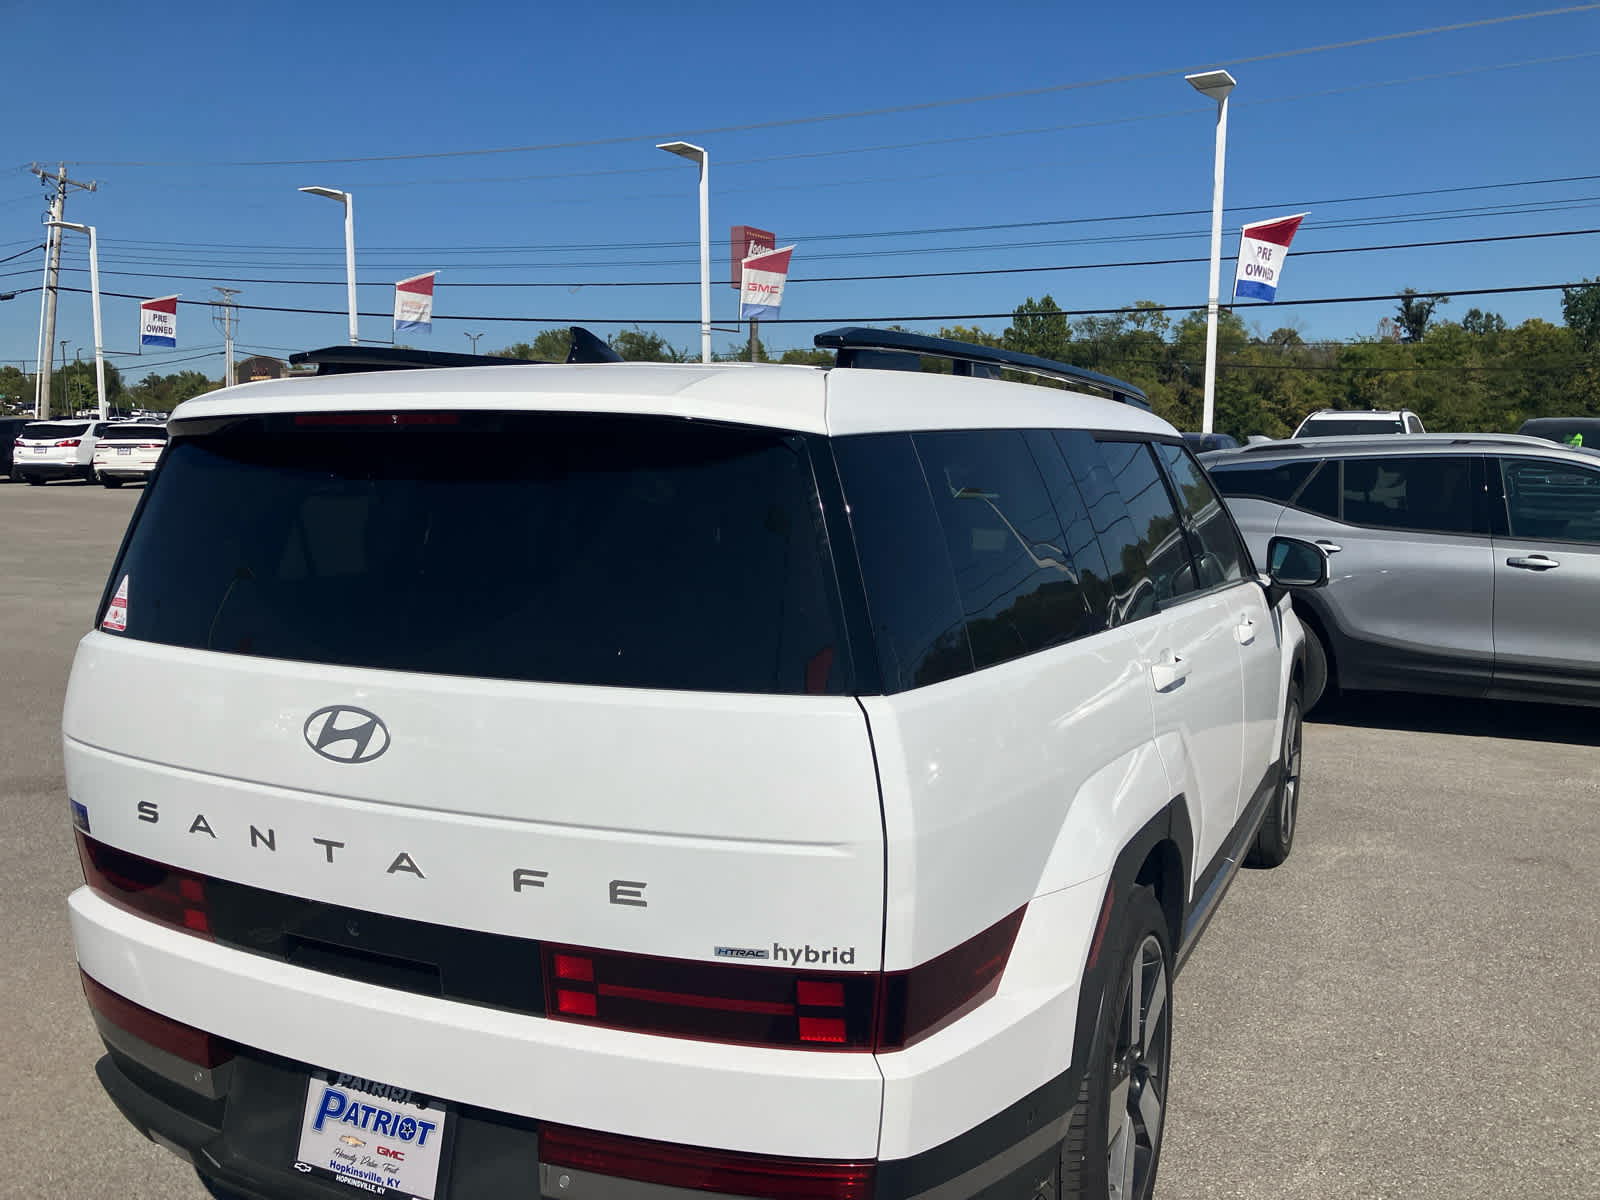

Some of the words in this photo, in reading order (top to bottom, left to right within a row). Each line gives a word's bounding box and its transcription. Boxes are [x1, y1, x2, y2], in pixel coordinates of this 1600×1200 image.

[1257, 246, 1273, 261] PRE
[747, 282, 780, 294] GMC
[153, 313, 168, 323] PRE
[146, 324, 173, 335] OWNED
[137, 800, 427, 880] SANTA
[512, 868, 648, 908] FE
[717, 948, 766, 958] HTRAC
[773, 943, 855, 966] hybrid
[312, 1087, 436, 1146] PATRIOT
[376, 1145, 405, 1161] GMC
[329, 1159, 384, 1186] Hopkinsville,
[387, 1177, 401, 1189] KY
[377, 1185, 386, 1195] KY
